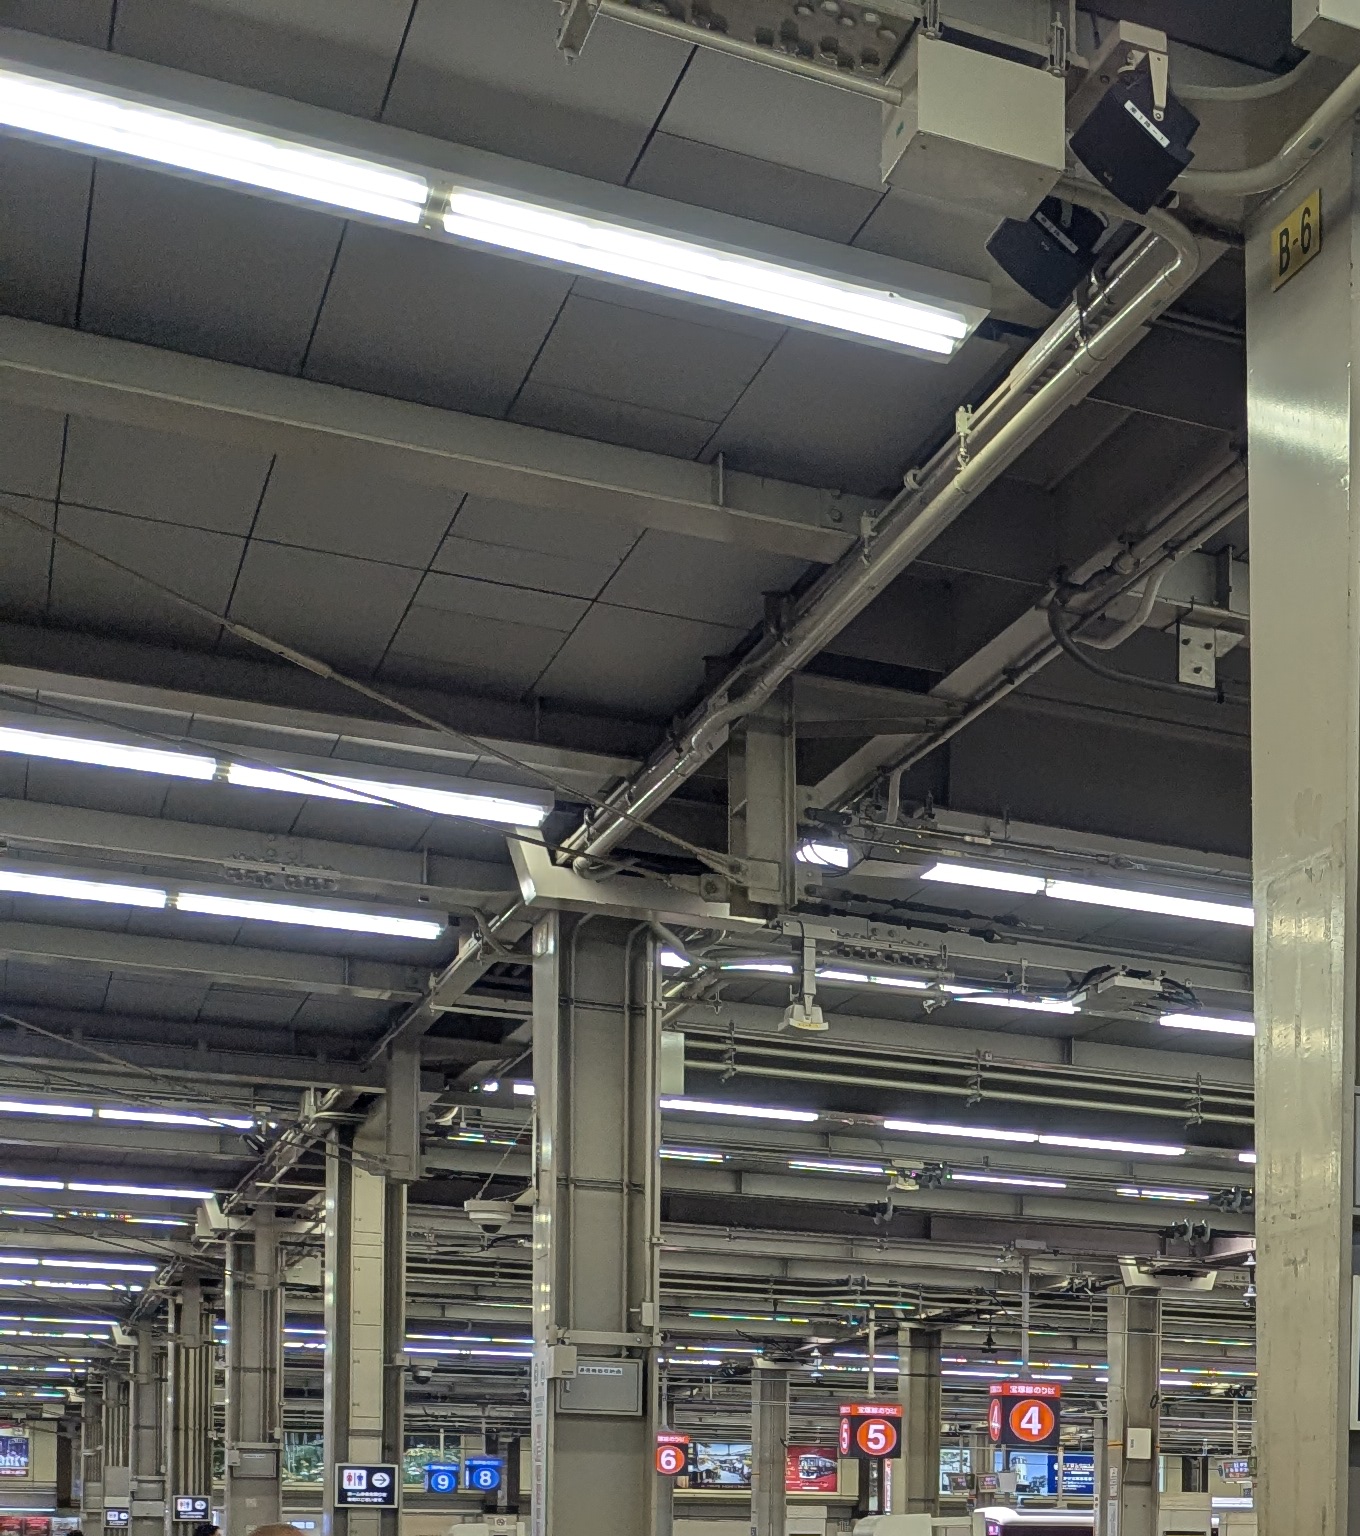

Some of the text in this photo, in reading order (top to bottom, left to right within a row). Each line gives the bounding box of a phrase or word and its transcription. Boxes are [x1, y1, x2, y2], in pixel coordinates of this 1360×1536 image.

[1279, 206, 1312, 277] B-6
[1019, 1406, 1042, 1436] 4
[866, 1424, 886, 1450] 5
[659, 1449, 677, 1470] 6
[437, 1474, 450, 1490] 9
[479, 1470, 492, 1486] 8
